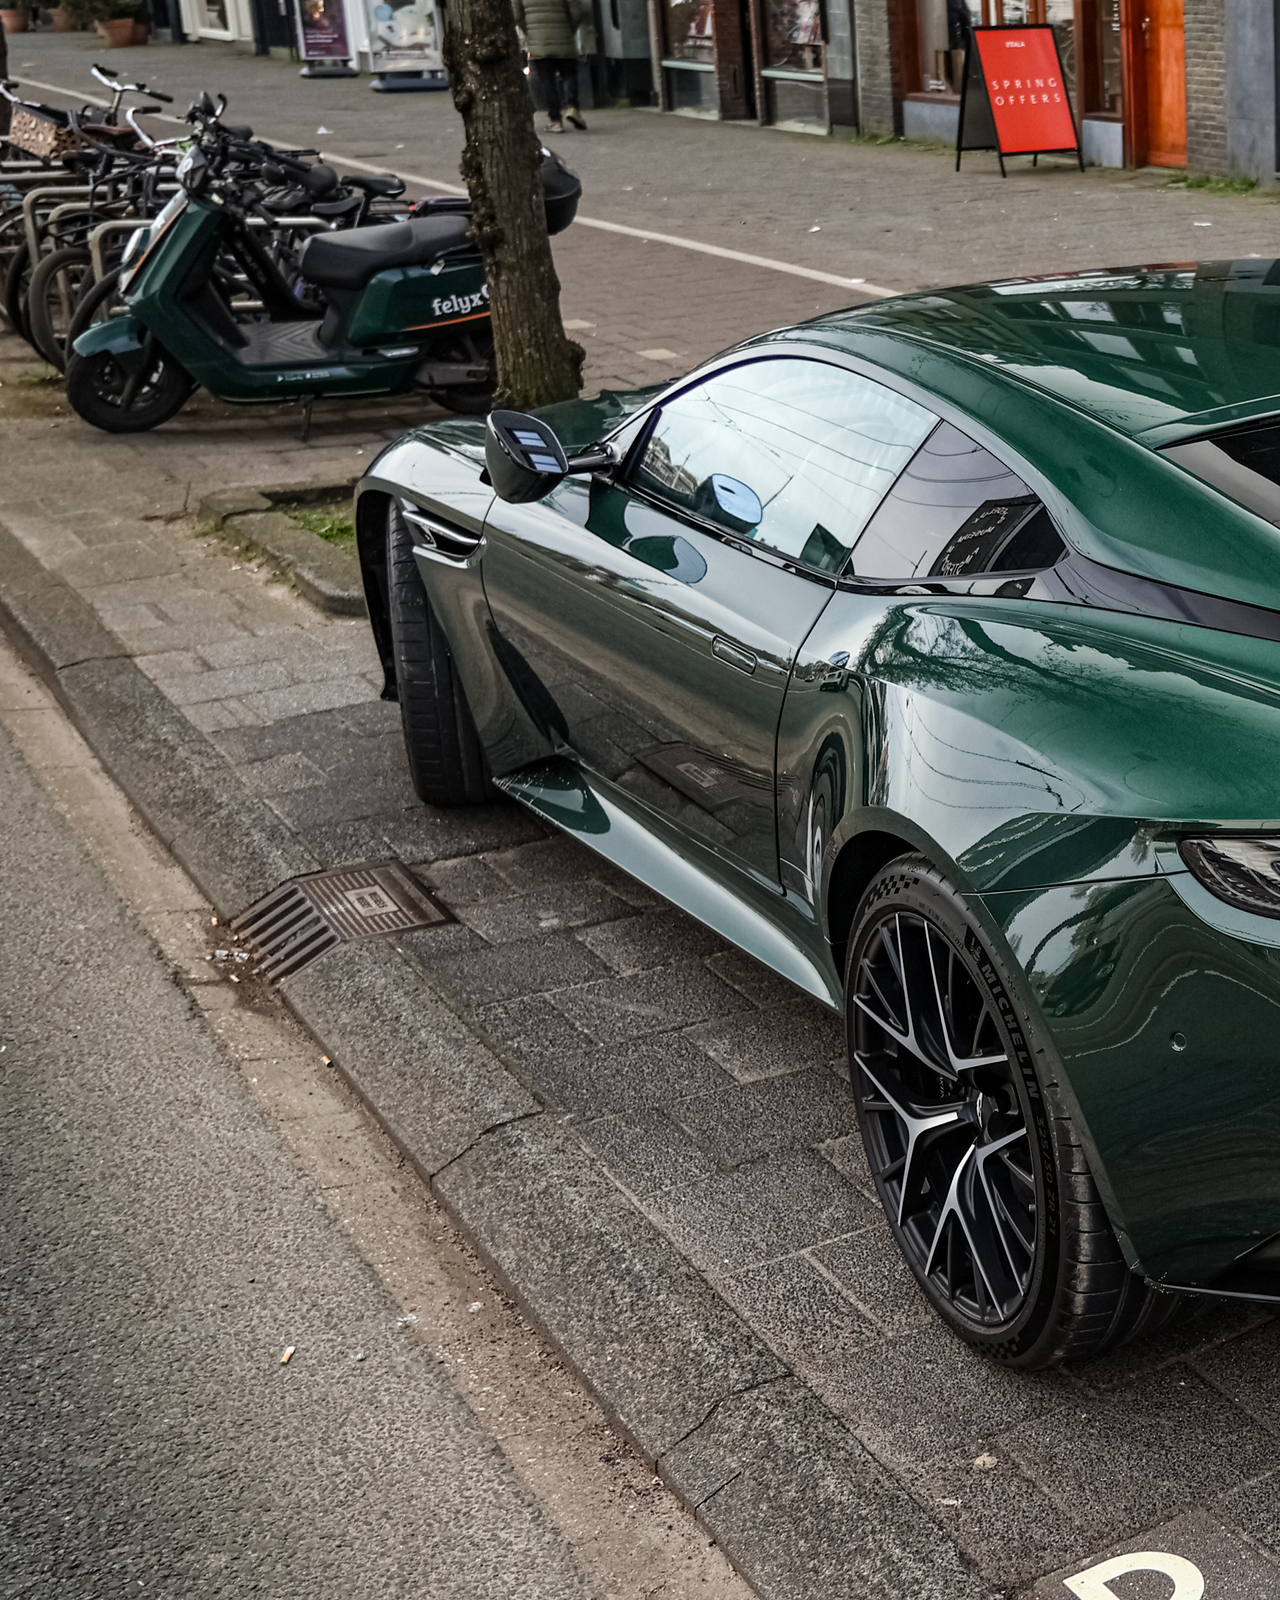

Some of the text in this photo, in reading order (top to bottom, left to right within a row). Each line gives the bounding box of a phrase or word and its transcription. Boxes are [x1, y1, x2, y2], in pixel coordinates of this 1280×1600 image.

[992, 78, 1058, 91] SPRING
[995, 93, 1061, 106] OFFERS
[432, 294, 484, 316] felyx
[981, 963, 1040, 1100] MICHELIN
[1036, 1115, 1057, 1236] 325/30 ZR 21
